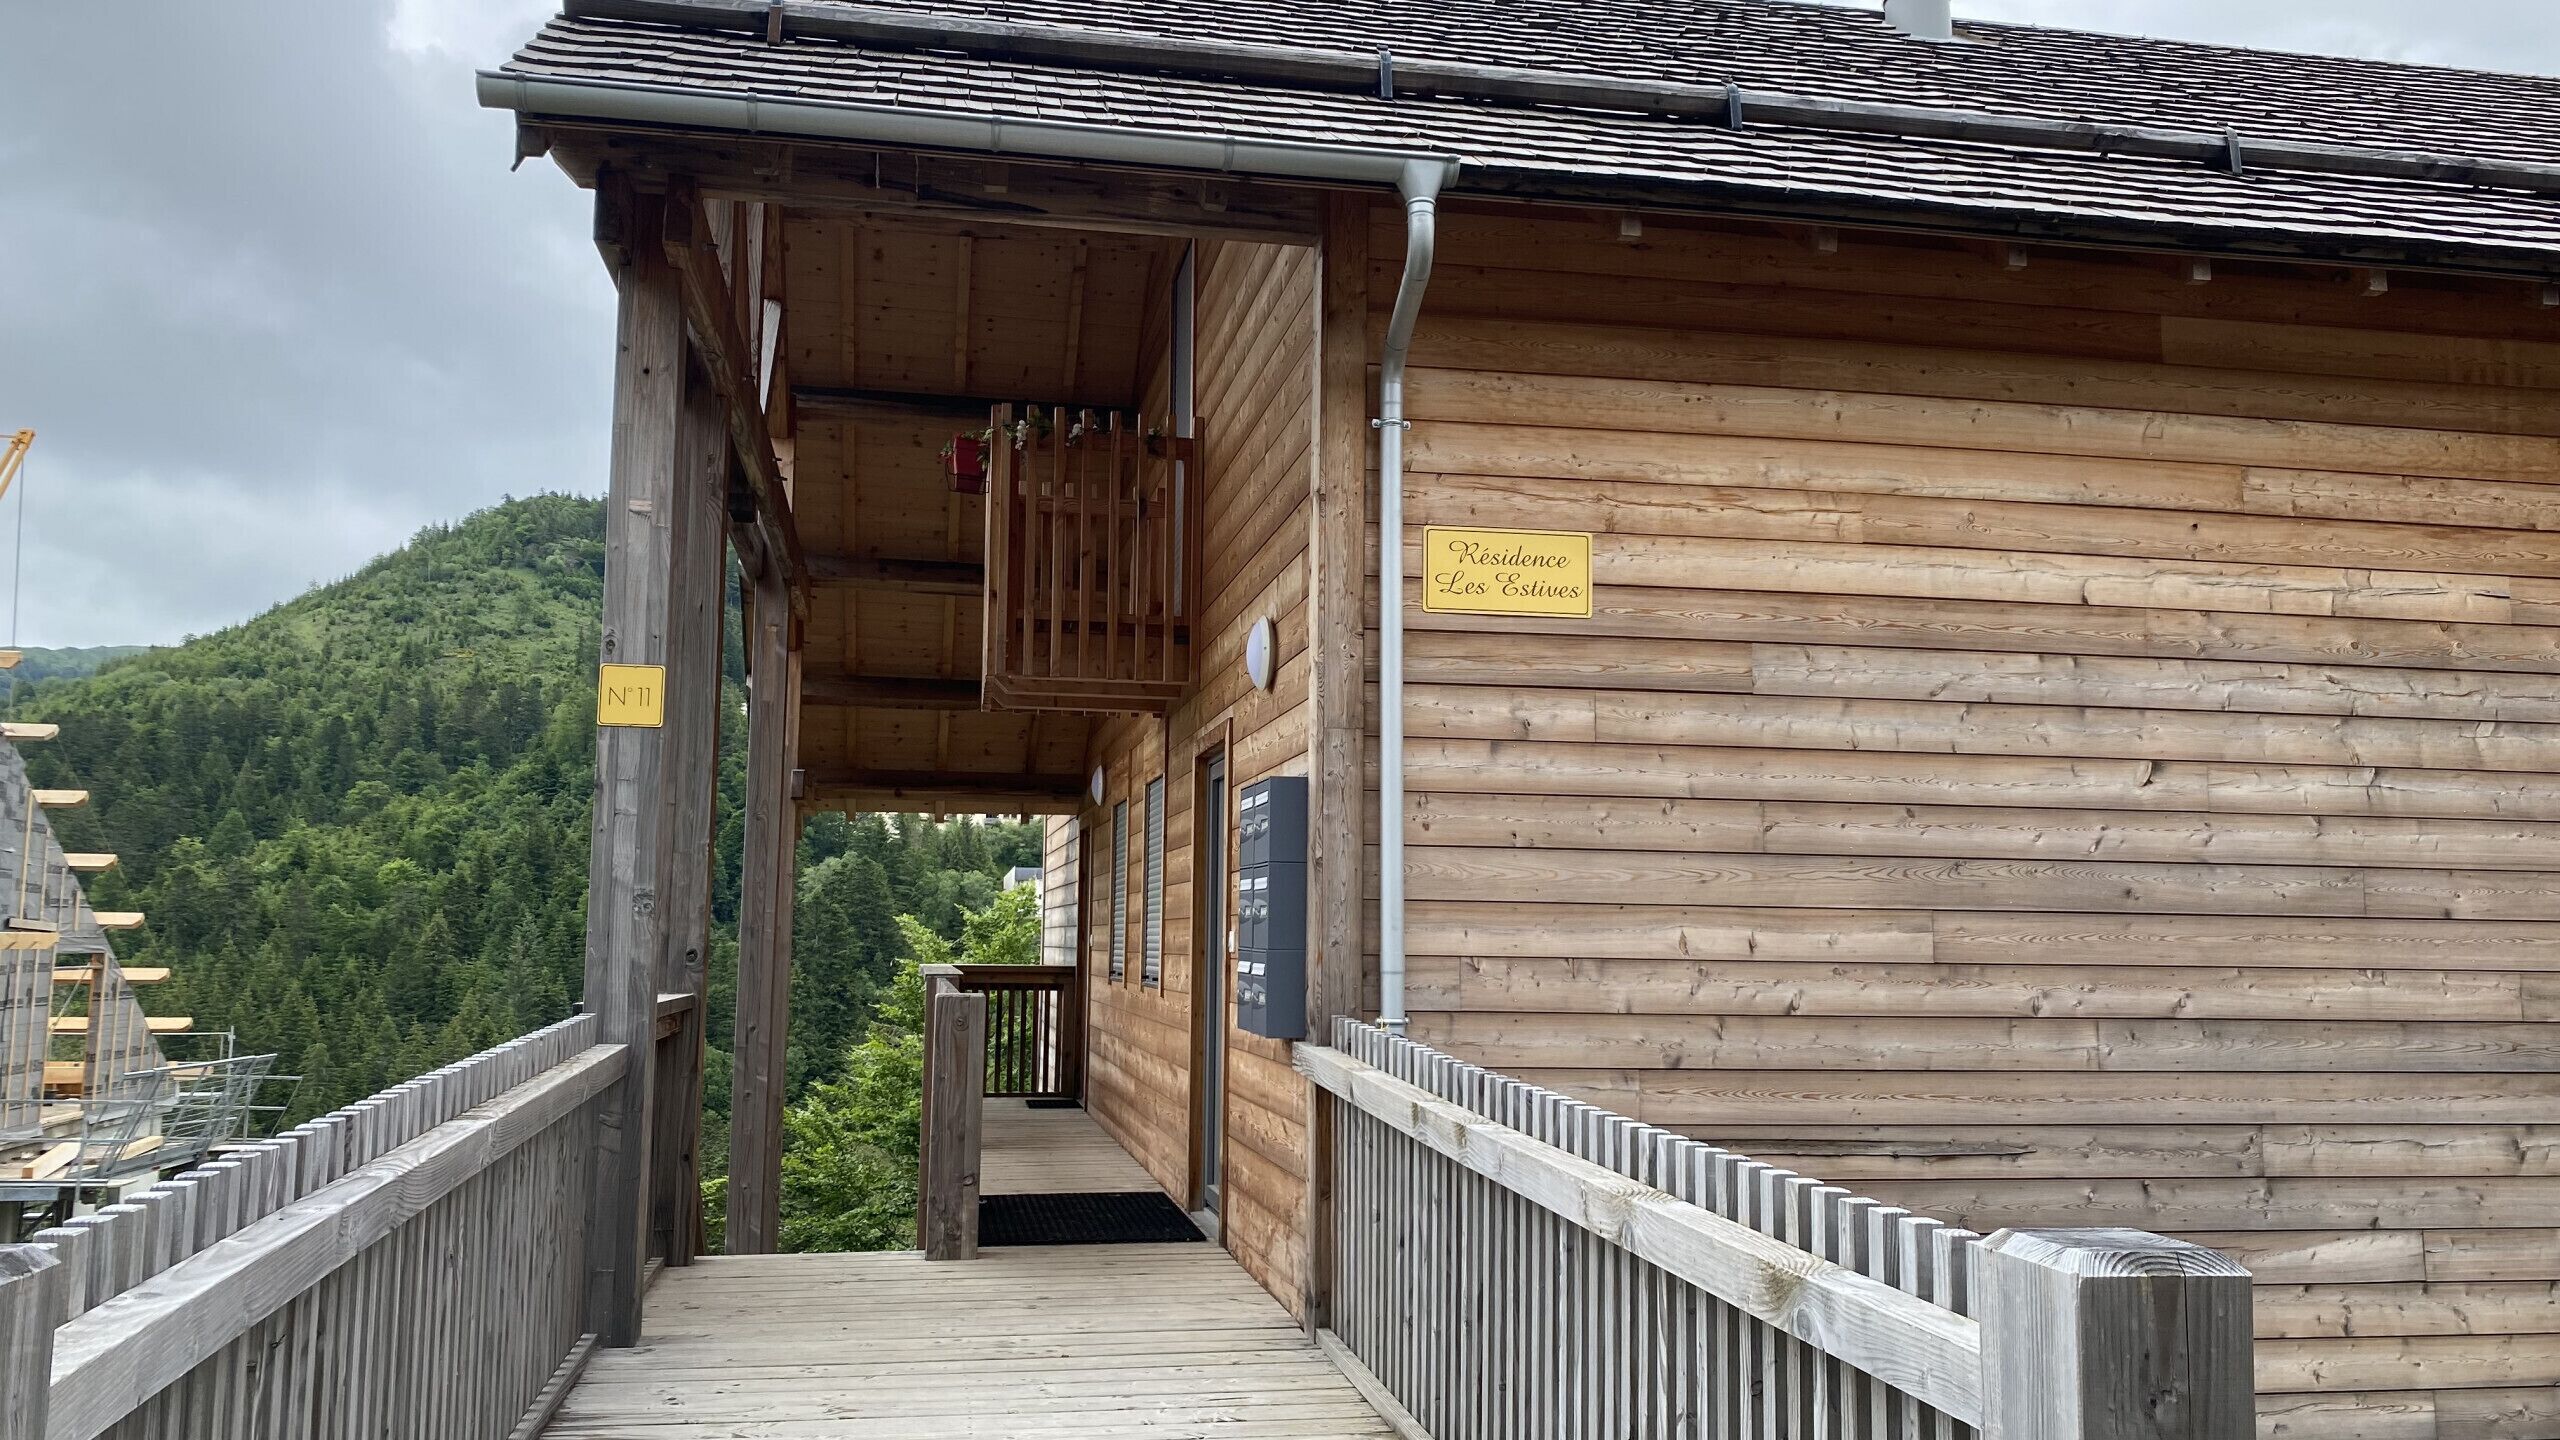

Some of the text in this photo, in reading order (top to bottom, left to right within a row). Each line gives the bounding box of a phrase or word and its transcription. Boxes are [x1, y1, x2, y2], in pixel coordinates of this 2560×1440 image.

[1448, 540, 1571, 569] Résidence
[1434, 570, 1584, 599] Les Estives
